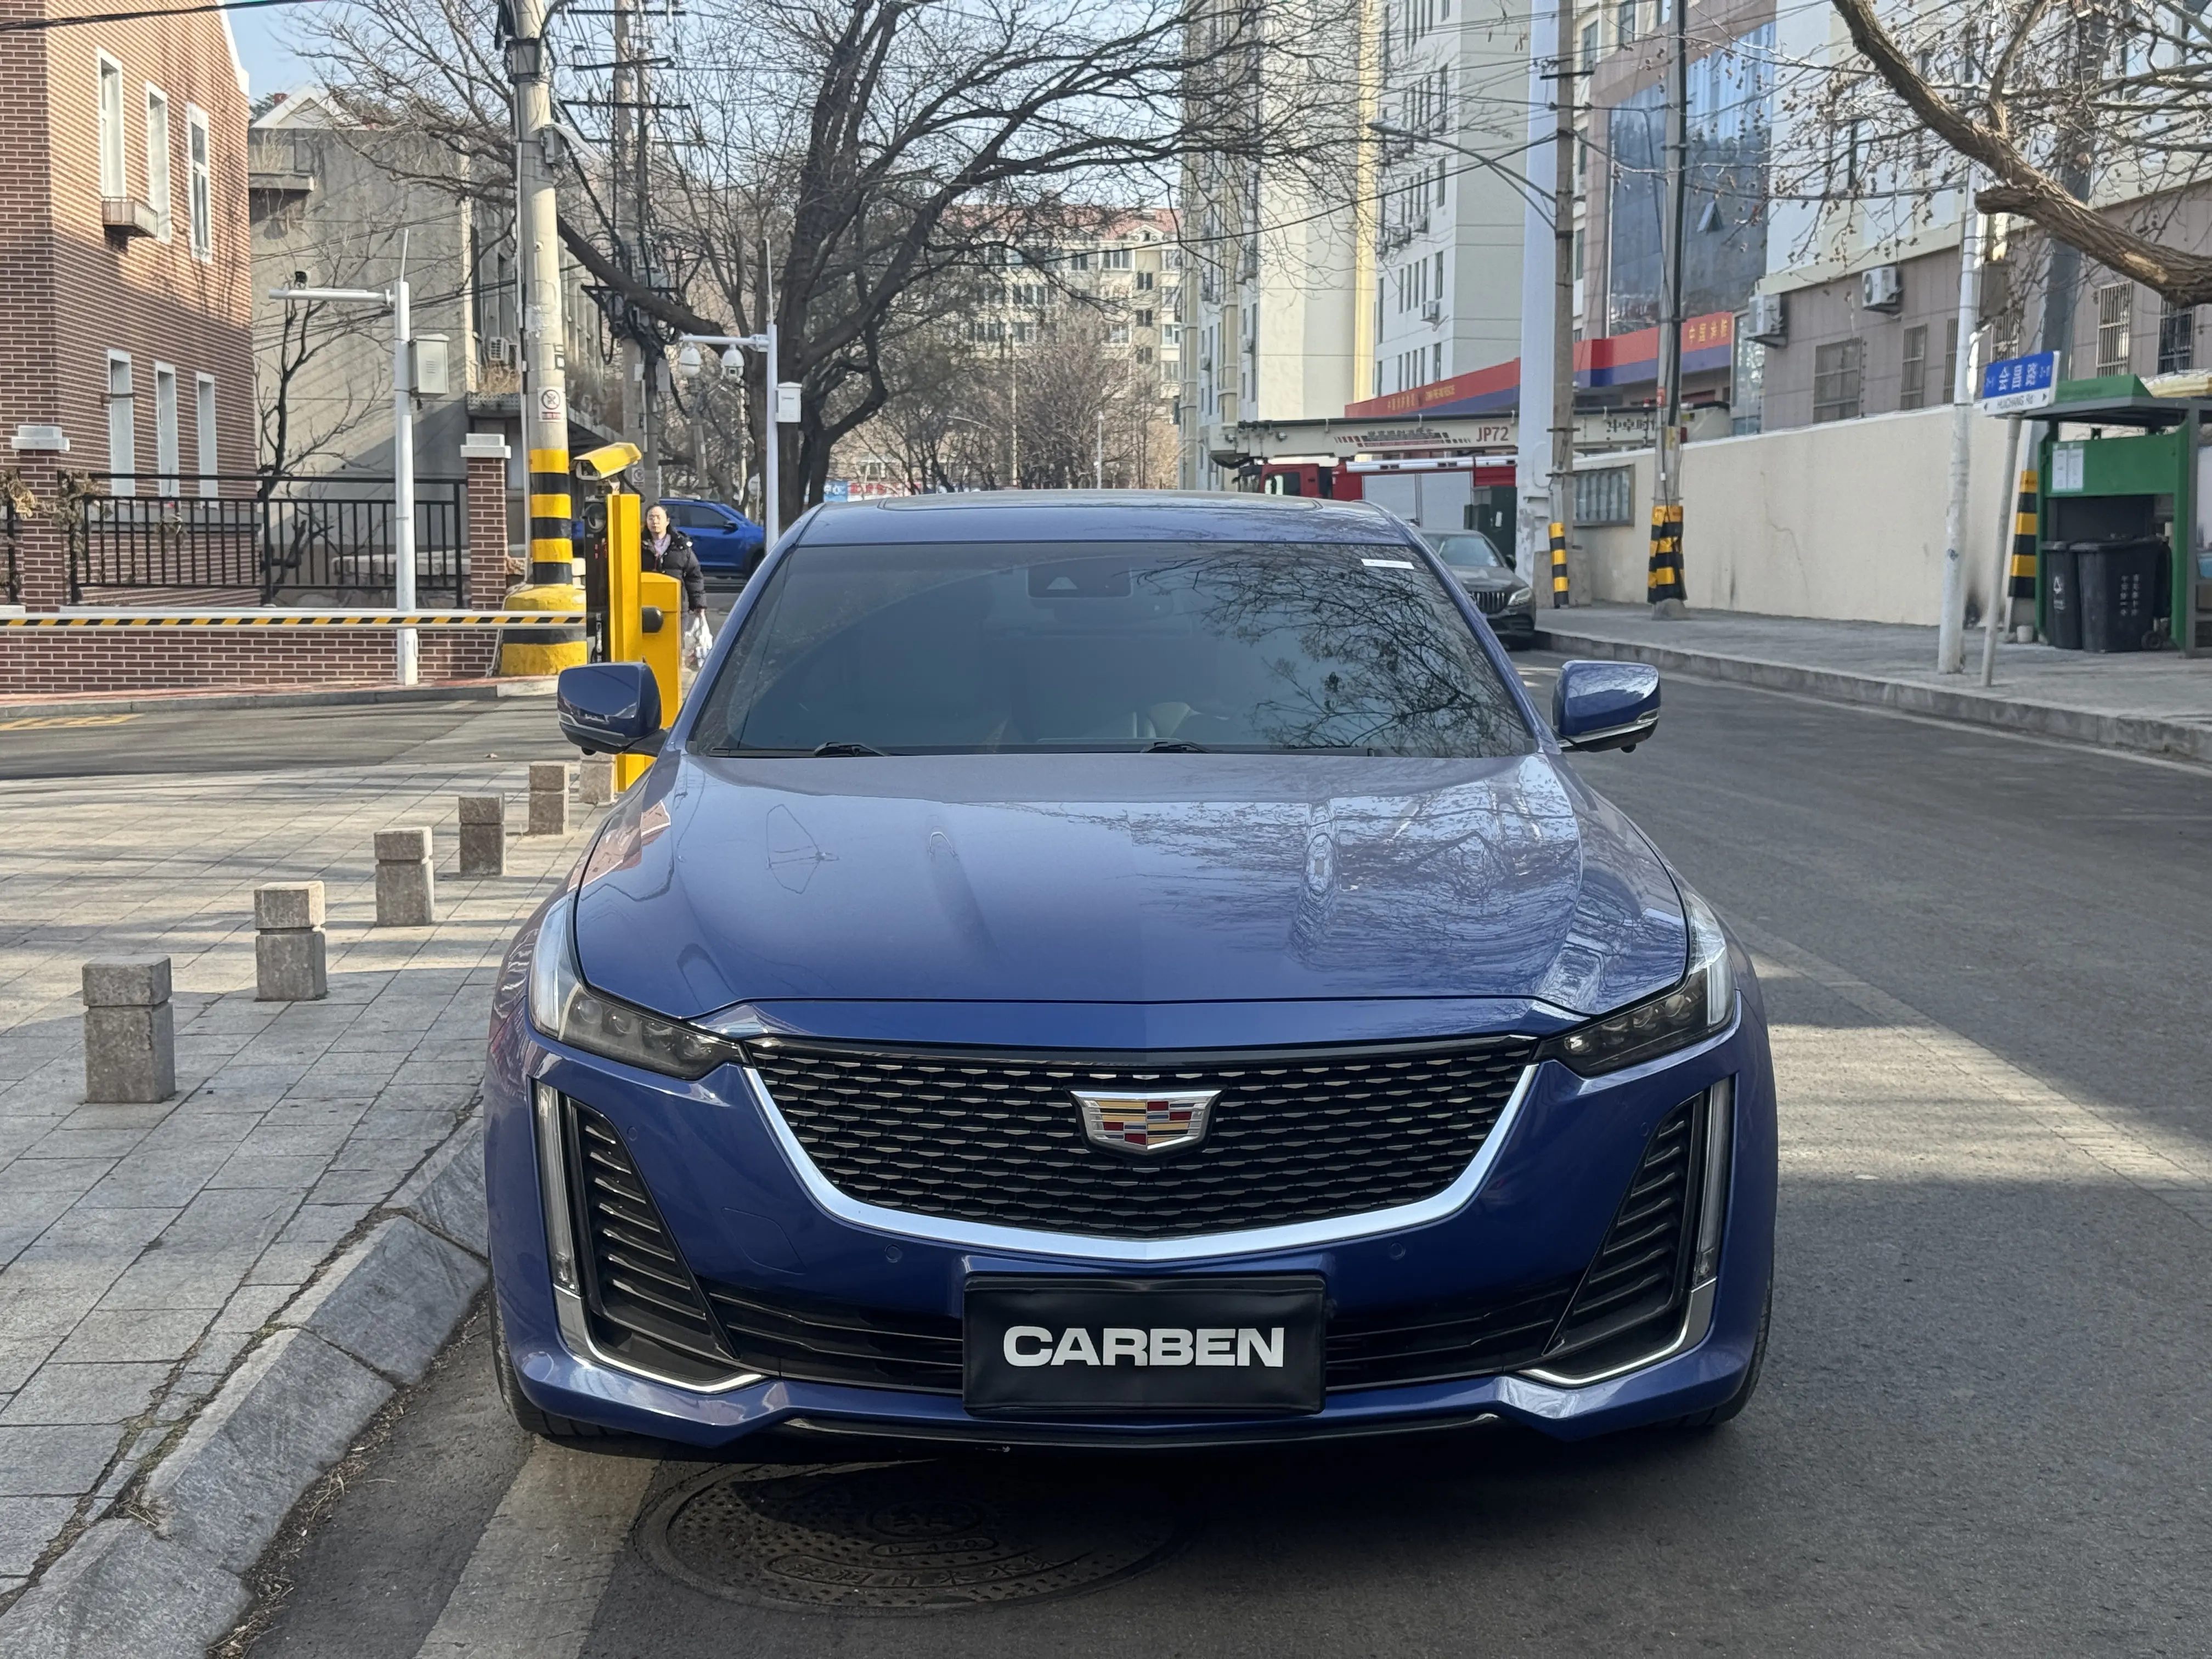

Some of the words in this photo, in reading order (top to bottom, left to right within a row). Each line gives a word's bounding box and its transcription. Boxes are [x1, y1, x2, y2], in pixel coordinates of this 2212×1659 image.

[1998, 363, 2038, 391] 会昌路
[1476, 426, 1509, 442] JP72
[1003, 1325, 1284, 1368] CARBEN
